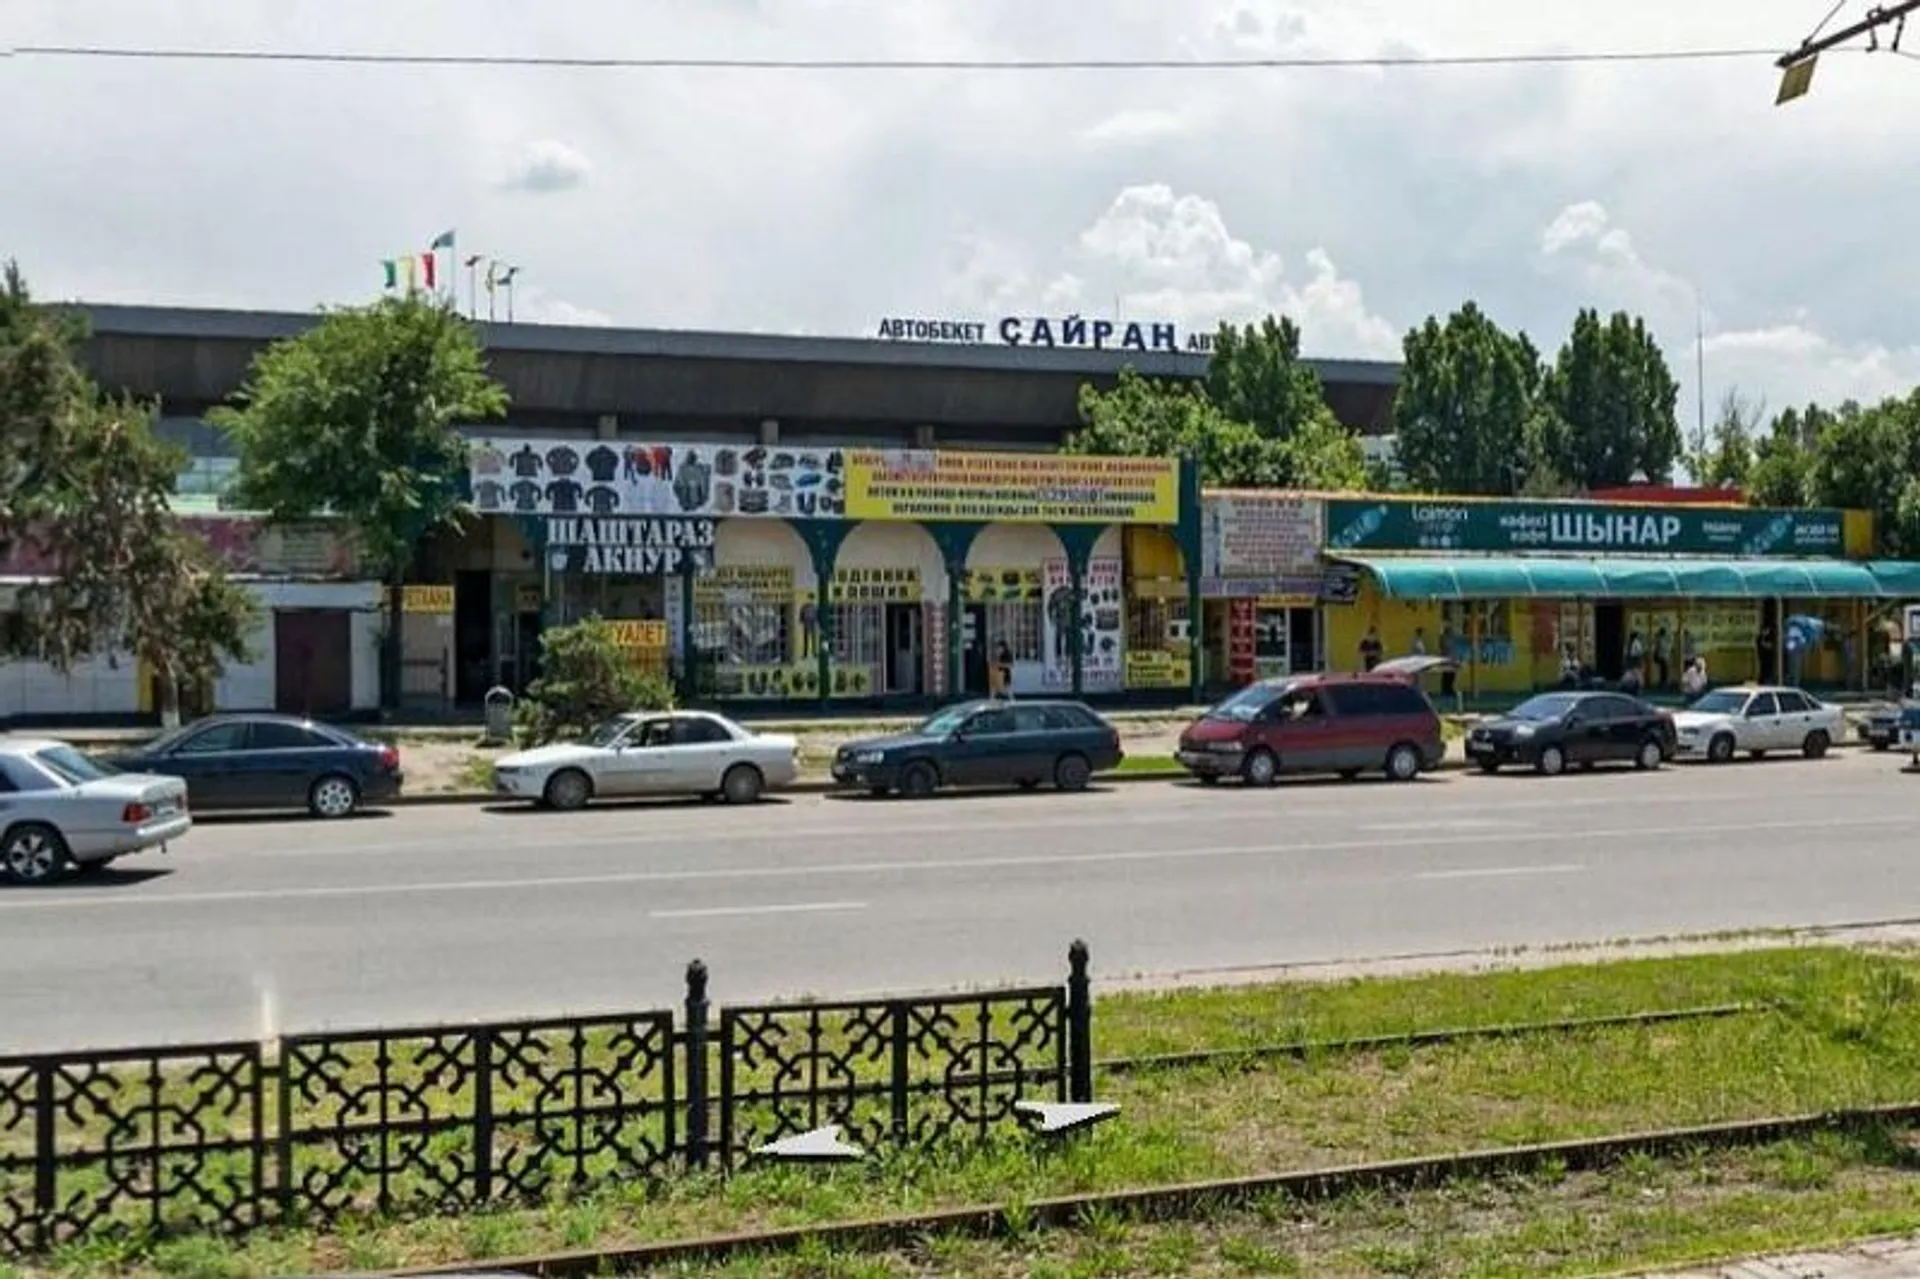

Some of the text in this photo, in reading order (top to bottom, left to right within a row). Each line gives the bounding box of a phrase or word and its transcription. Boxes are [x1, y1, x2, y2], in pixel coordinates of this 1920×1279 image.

[879, 318, 986, 341] АВТОБЕКЕТ
[547, 519, 714, 546] ШАШТАРАЗ
[1551, 513, 1681, 545] ШЫНАР
[584, 547, 682, 573] АКНУР
